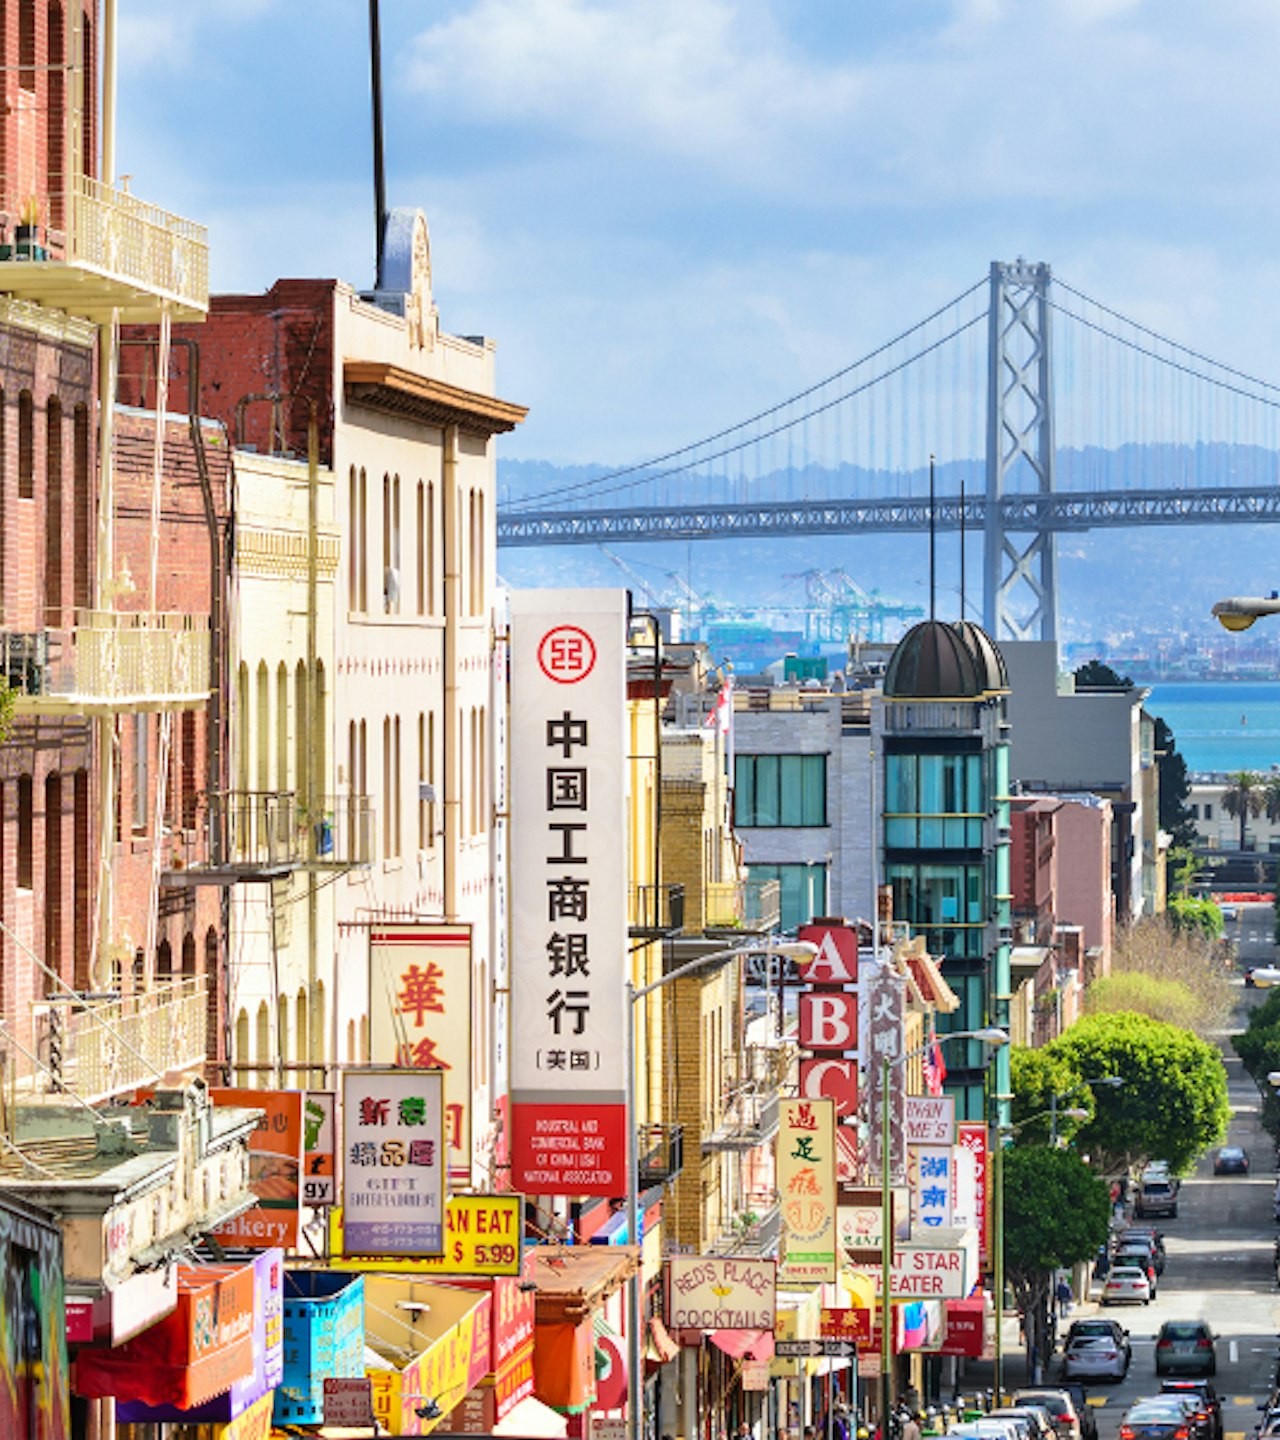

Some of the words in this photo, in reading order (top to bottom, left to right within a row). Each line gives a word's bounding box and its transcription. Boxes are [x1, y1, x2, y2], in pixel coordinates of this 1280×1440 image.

[545, 711, 591, 1035] 中国工商银行
[581, 1120, 598, 1133] AND
[583, 1137, 606, 1150] BANK
[366, 1178, 418, 1191] GIFT
[523, 1170, 561, 1183] NATIONAL
[562, 1170, 613, 1184] ASSOCIATION
[476, 1209, 514, 1234] EAT
[913, 1252, 961, 1271] STAR
[673, 1262, 718, 1297] RED'S
[723, 1262, 771, 1297] PLACE
[675, 1309, 771, 1328] COCKTAILS
